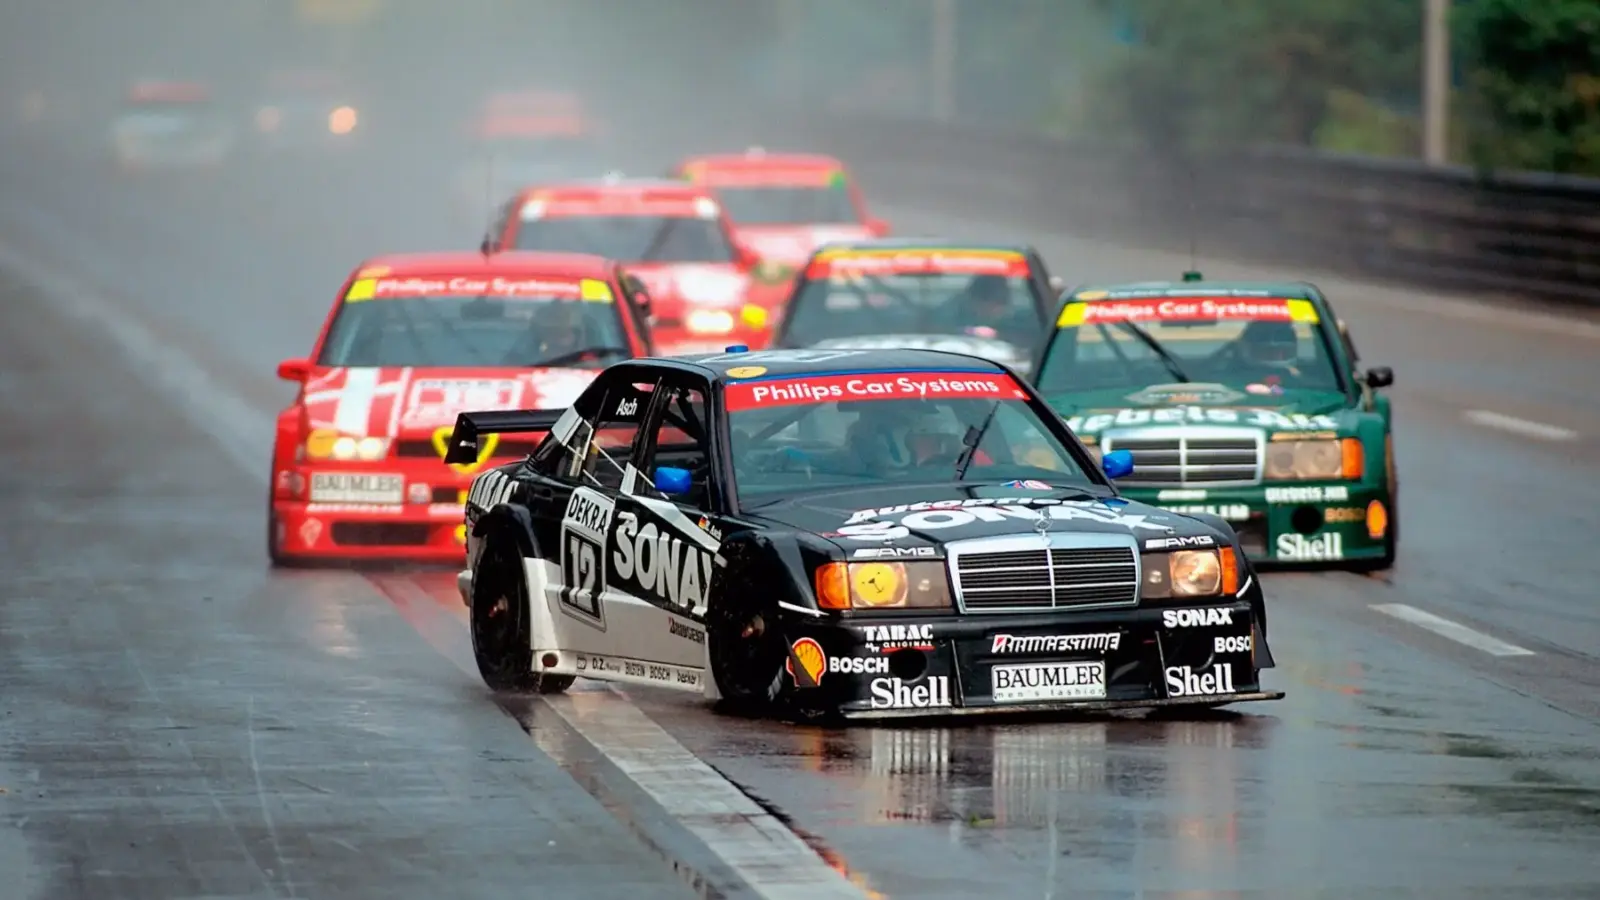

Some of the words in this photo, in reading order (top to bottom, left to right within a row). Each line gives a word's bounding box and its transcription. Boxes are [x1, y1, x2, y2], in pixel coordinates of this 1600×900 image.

[1084, 303, 1154, 321] Philips
[1158, 300, 1197, 315] Car
[1201, 300, 1290, 317] Systems
[752, 382, 843, 402] Philips
[846, 379, 894, 395] Car
[899, 377, 1000, 397] Systems
[615, 397, 638, 417] Asch
[568, 493, 609, 536] DEKRA
[836, 505, 1176, 541] SONAX
[1164, 535, 1214, 547] AMG
[1275, 532, 1344, 561] Shell
[877, 546, 936, 558] AMG
[570, 534, 596, 612] 12
[1162, 607, 1234, 628] SONAX
[863, 624, 934, 642] TABAC
[991, 632, 1121, 654] BRIDGESTONE
[883, 640, 933, 649] ORIGINAL
[1214, 635, 1252, 653] BOSC
[649, 666, 671, 682] BOSCH
[829, 656, 890, 674] BOSCH
[995, 664, 1103, 689] BÄUMLER
[1165, 662, 1236, 697] Shell
[870, 675, 953, 709] Shell
